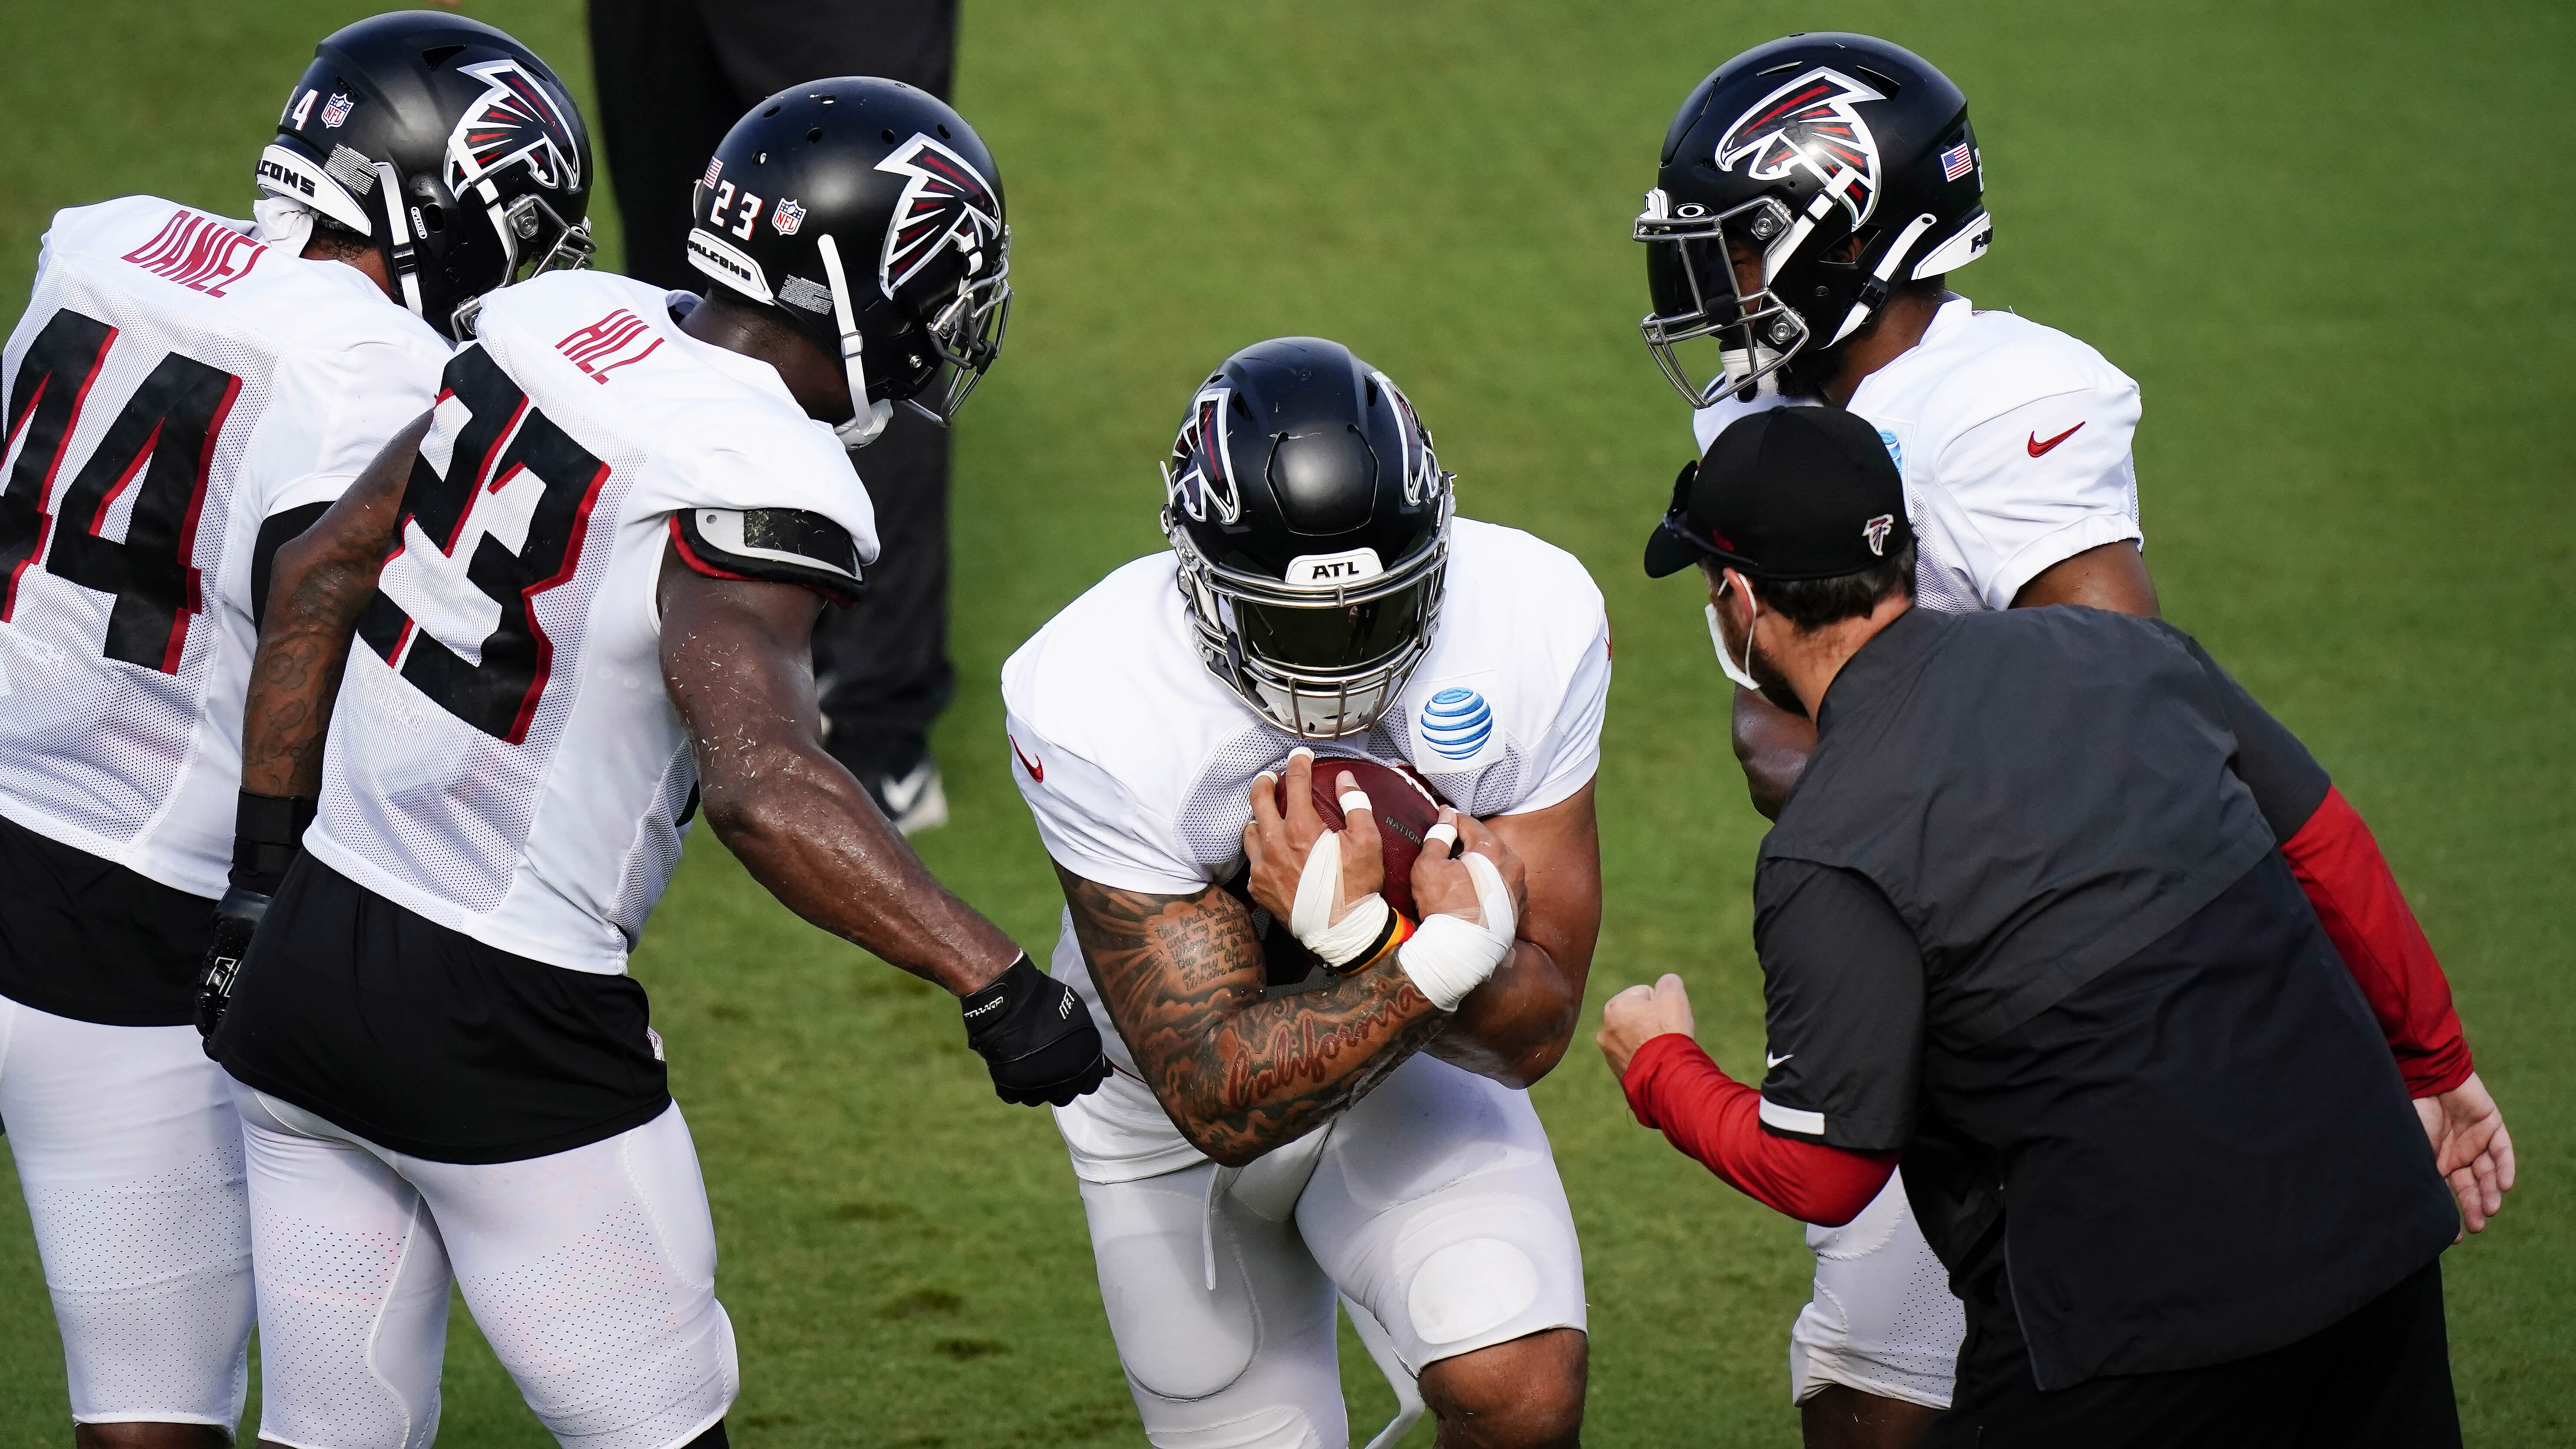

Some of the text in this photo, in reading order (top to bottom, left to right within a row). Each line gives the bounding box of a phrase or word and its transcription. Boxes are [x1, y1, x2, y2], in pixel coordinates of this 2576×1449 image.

[325, 106, 342, 124] NFL
[710, 179, 764, 241] 23
[776, 213, 795, 230] NFL
[120, 210, 269, 298] DANIEL
[688, 240, 751, 281] FALCONS
[555, 309, 665, 385] HILL
[0, 307, 243, 675] 44
[356, 342, 612, 746] 23
[1312, 562, 1359, 579] ATL
[1385, 816, 1423, 847] NATION
[1228, 981, 1431, 1109] California
